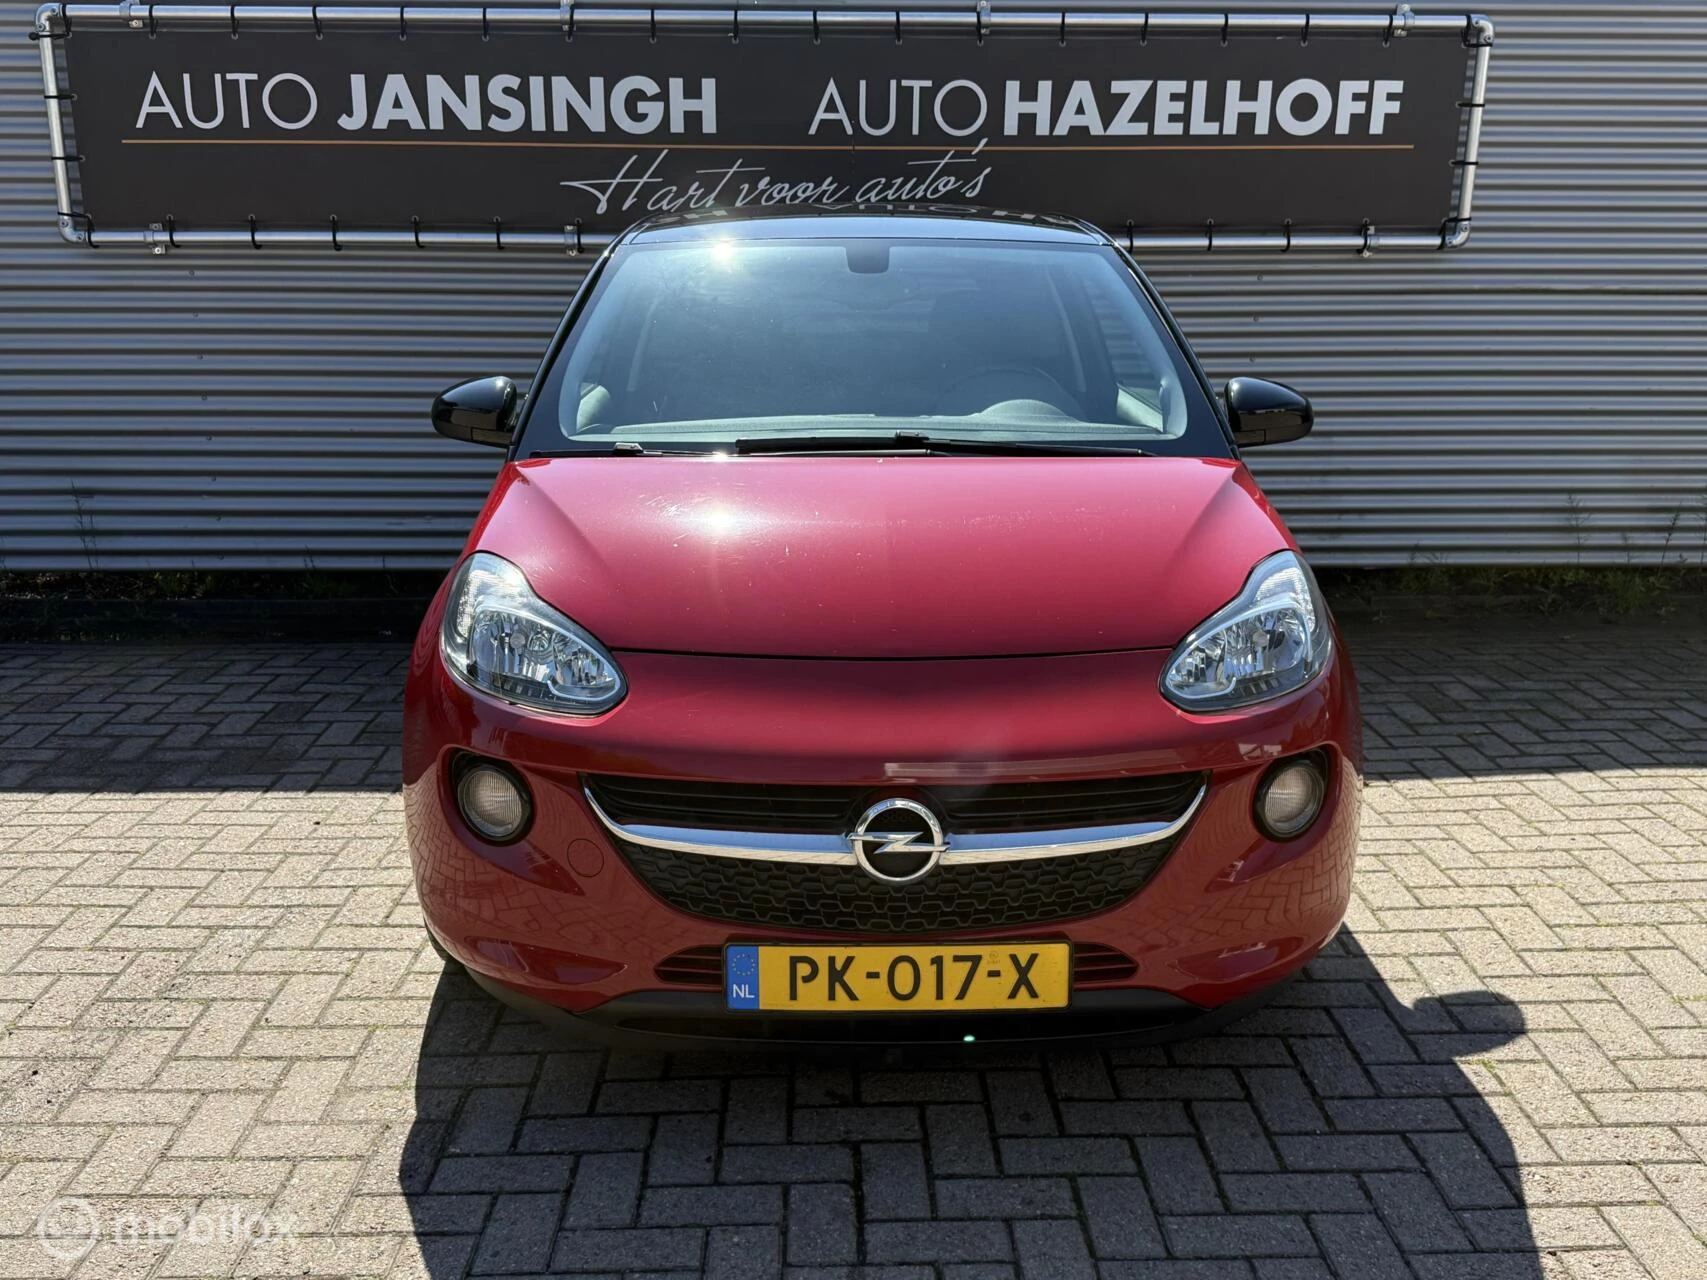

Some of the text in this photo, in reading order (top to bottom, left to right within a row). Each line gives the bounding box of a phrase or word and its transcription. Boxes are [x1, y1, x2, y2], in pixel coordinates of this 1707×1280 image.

[135, 70, 717, 135] AUTO JANSINGH
[807, 76, 1404, 137] AUTO HAZELHOFF
[559, 148, 766, 215] Hart
[734, 174, 851, 208] voor
[732, 983, 755, 999] NL
[788, 952, 1041, 1001] PK-017-X
